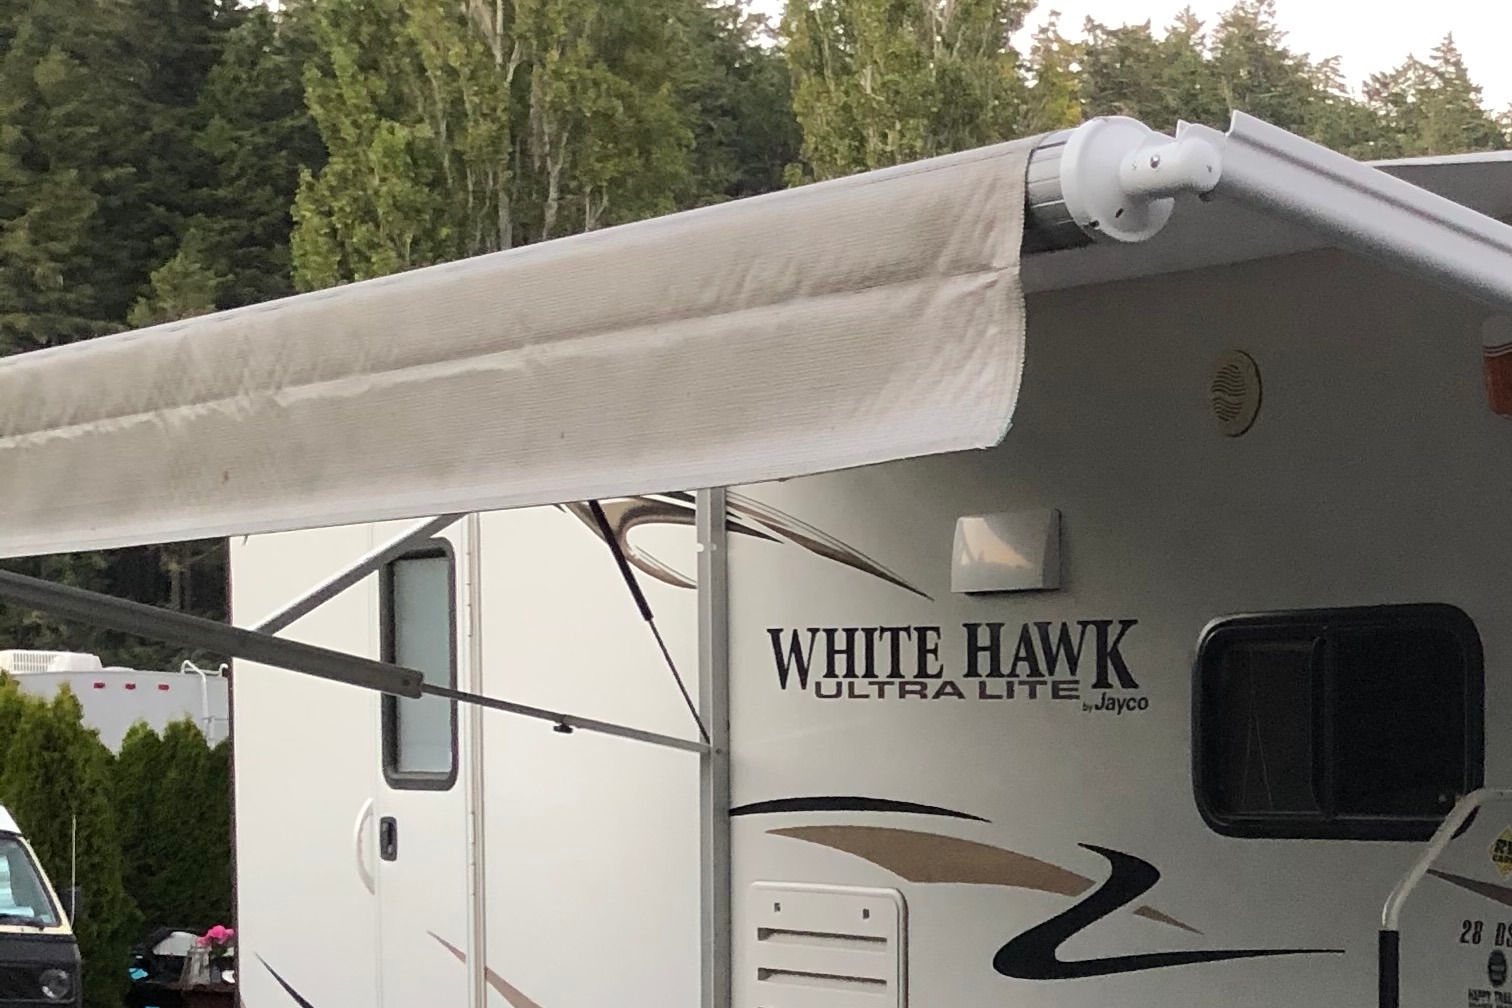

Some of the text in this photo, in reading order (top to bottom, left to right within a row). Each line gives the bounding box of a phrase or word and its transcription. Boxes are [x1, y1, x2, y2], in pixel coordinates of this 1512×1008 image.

[766, 619, 1140, 690] WHITE HAWK
[815, 680, 1081, 699] ULTRA LITE
[1082, 694, 1149, 715] by Jayco
[1460, 919, 1484, 945] 28
